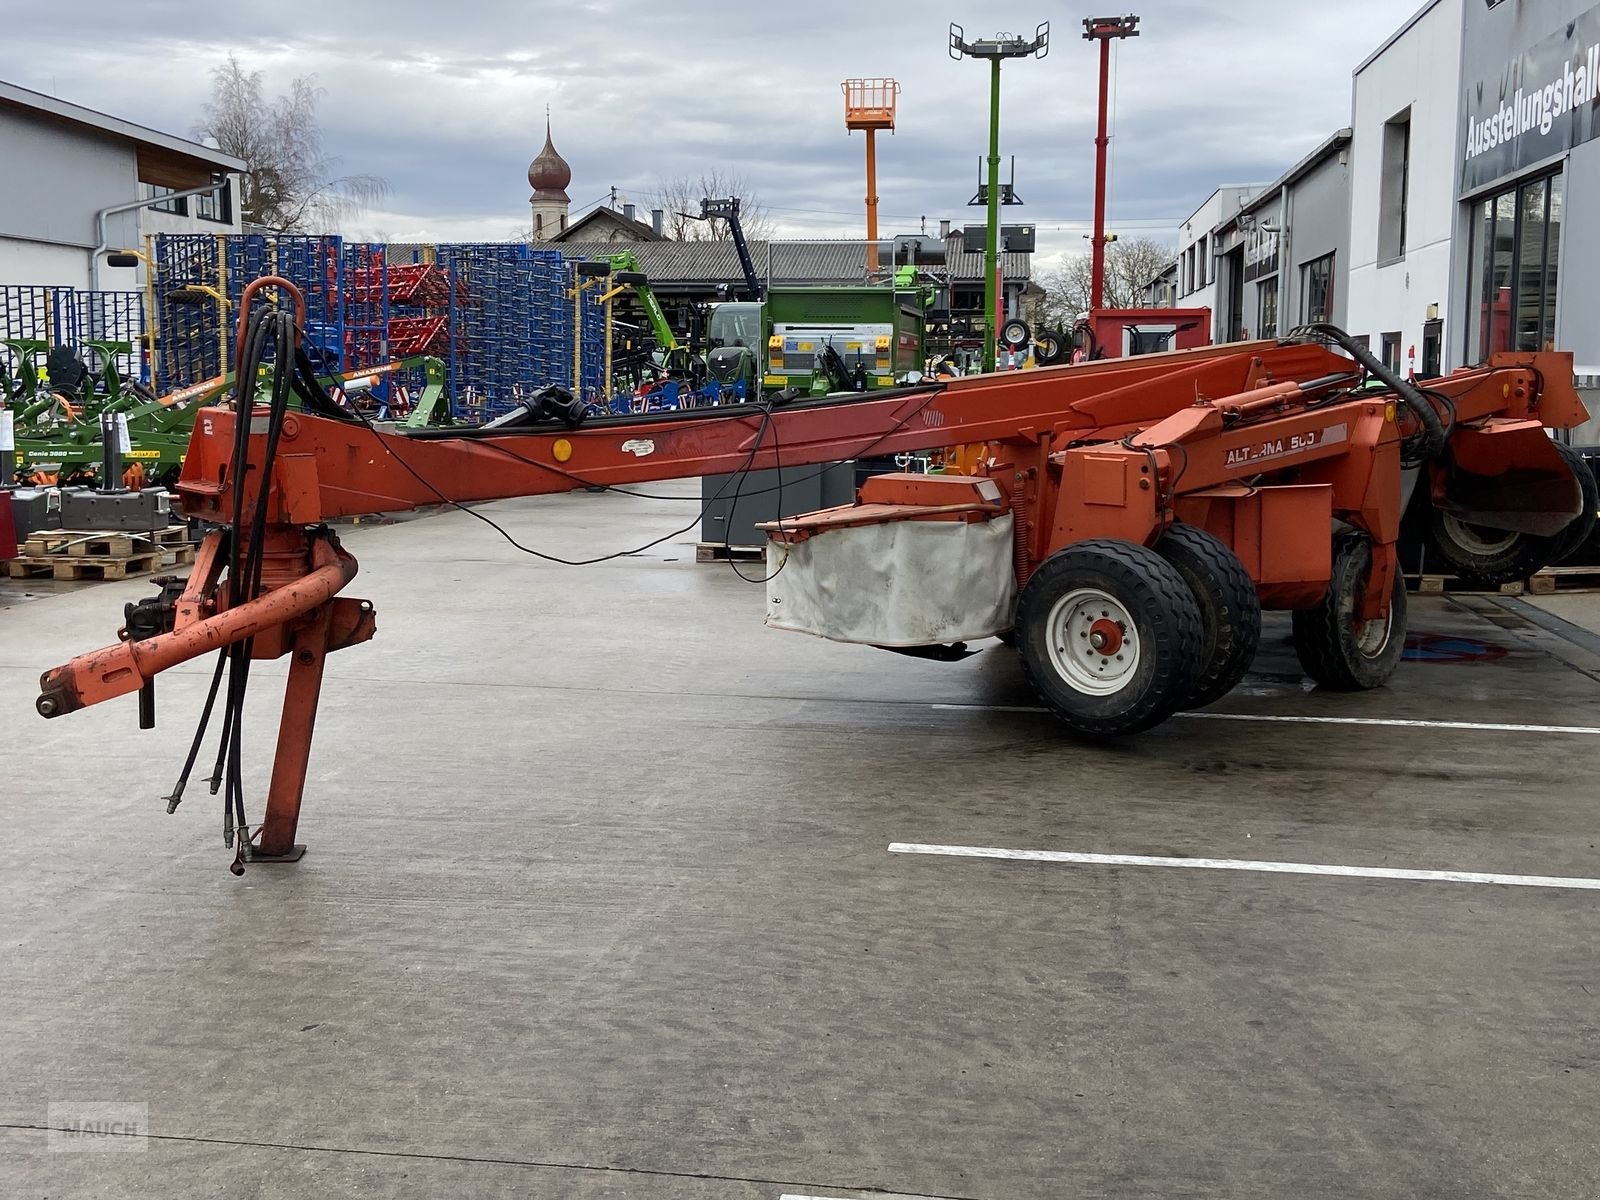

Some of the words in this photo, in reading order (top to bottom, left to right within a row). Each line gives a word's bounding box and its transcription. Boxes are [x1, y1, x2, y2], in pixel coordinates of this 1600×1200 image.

[1465, 42, 1600, 161] Ausstellungshall
[353, 364, 393, 377] AMAZONE
[171, 381, 216, 402] AMAZONE
[203, 418, 214, 436] 2
